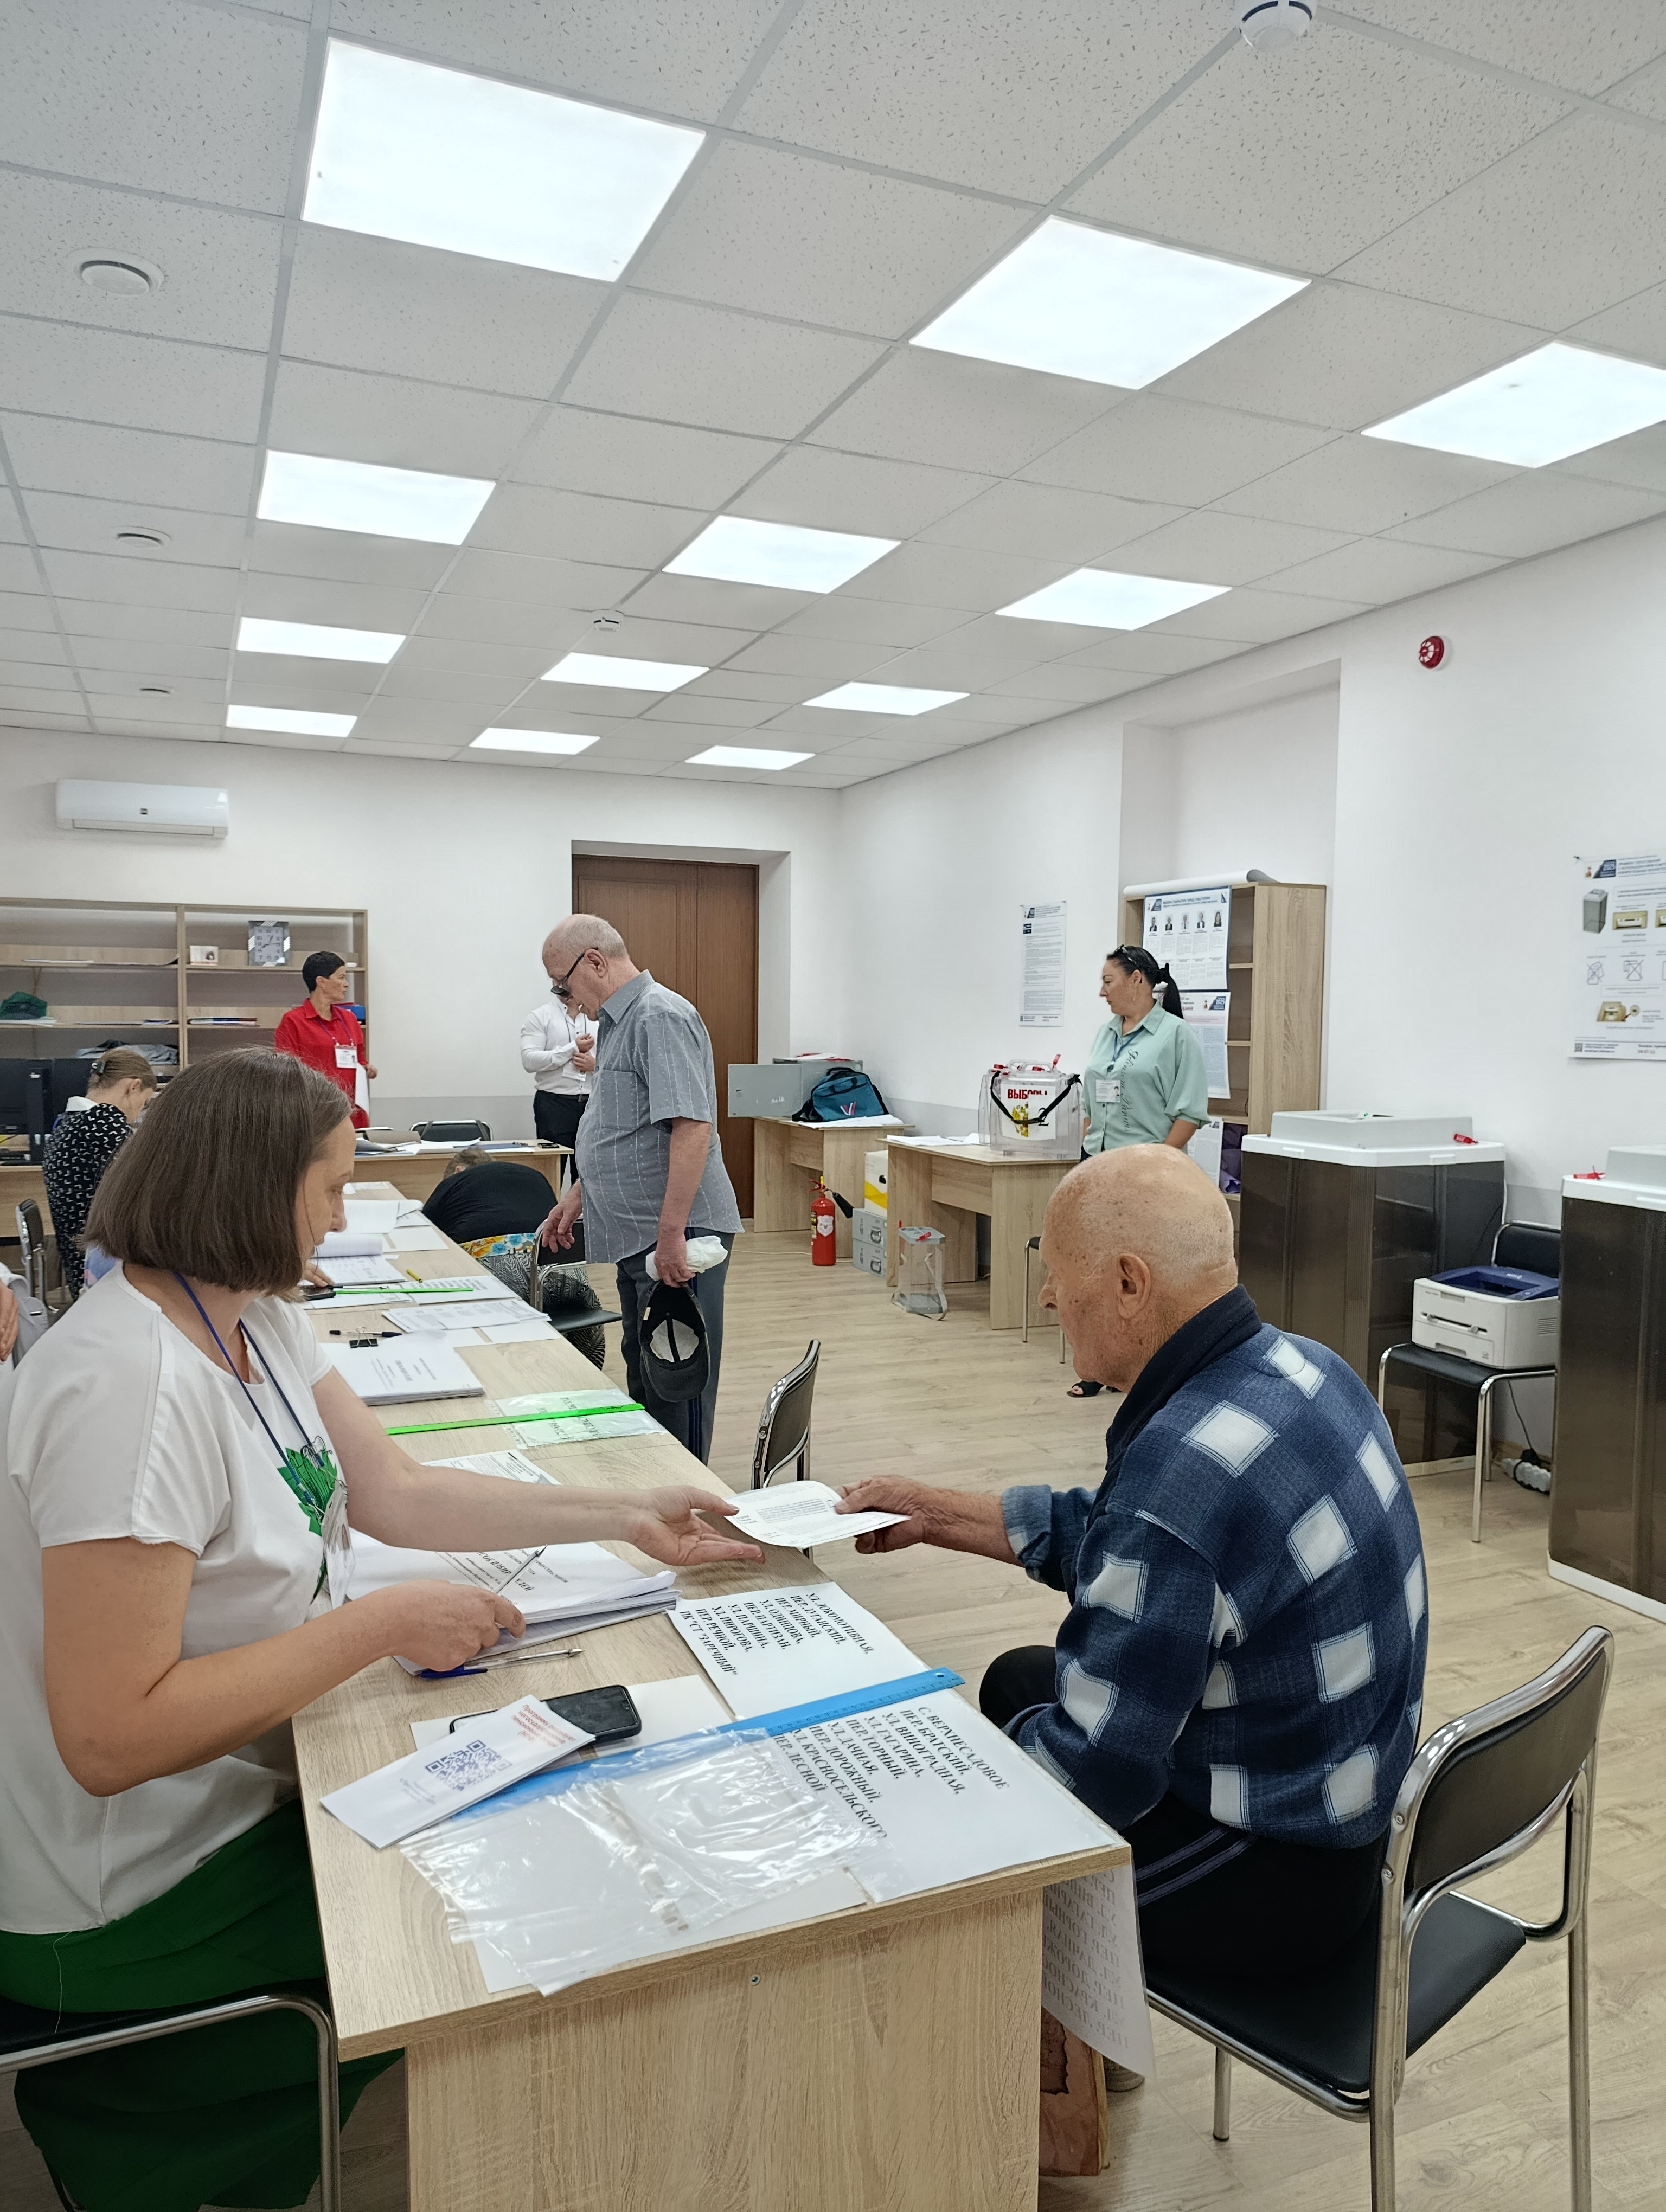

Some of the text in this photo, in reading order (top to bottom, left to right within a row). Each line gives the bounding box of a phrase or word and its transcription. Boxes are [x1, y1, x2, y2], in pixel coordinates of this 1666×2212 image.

[1008, 1089, 1047, 1099] ВЫБ
[1038, 1108, 1049, 1126] 2
[490, 1560, 535, 1591] ИЗБИРЕЛЕЙ
[696, 1609, 736, 1650] ПЕР. РЕЧНОЙ,
[712, 1606, 753, 1652] УЛ. ПИРОГОВА,
[728, 1604, 769, 1648] УЛ. ПАРШИНА,
[743, 1602, 791, 1649] ПЕР. ПАРТИЗАН,
[760, 1600, 804, 1644] УЛ. ОДИНЦОВА,
[774, 1598, 822, 1638] ПЕР. МИРНЫЙ,
[790, 1596, 848, 1644] ПЕР. ЛУГАНСКИЙ,
[806, 1593, 874, 1654] УЛ. ЛОКОМОТИВНАЯ,
[680, 1611, 694, 1620] ПК
[699, 1633, 738, 1675] "ЗАРЕЧНЫЙ"
[790, 1729, 808, 1742] УЛ.
[828, 1722, 879, 1775] УЛ. ДАЧНАЯ,
[846, 1719, 907, 1779] ПЕР. ГОРНЫЙ,
[864, 1716, 924, 1777] УЛ. ГАГАРИНА,
[882, 1713, 965, 1795] УЛ. ВИНОГРАДНАЯ,
[900, 1709, 972, 1776] ПЕР. БРАТСКИЙ,
[927, 1715, 1009, 1789] ВЕРХНЕСАДОВОЕ
[809, 1726, 882, 1803] ПЕР. ДОРОЖНЫЙ,
